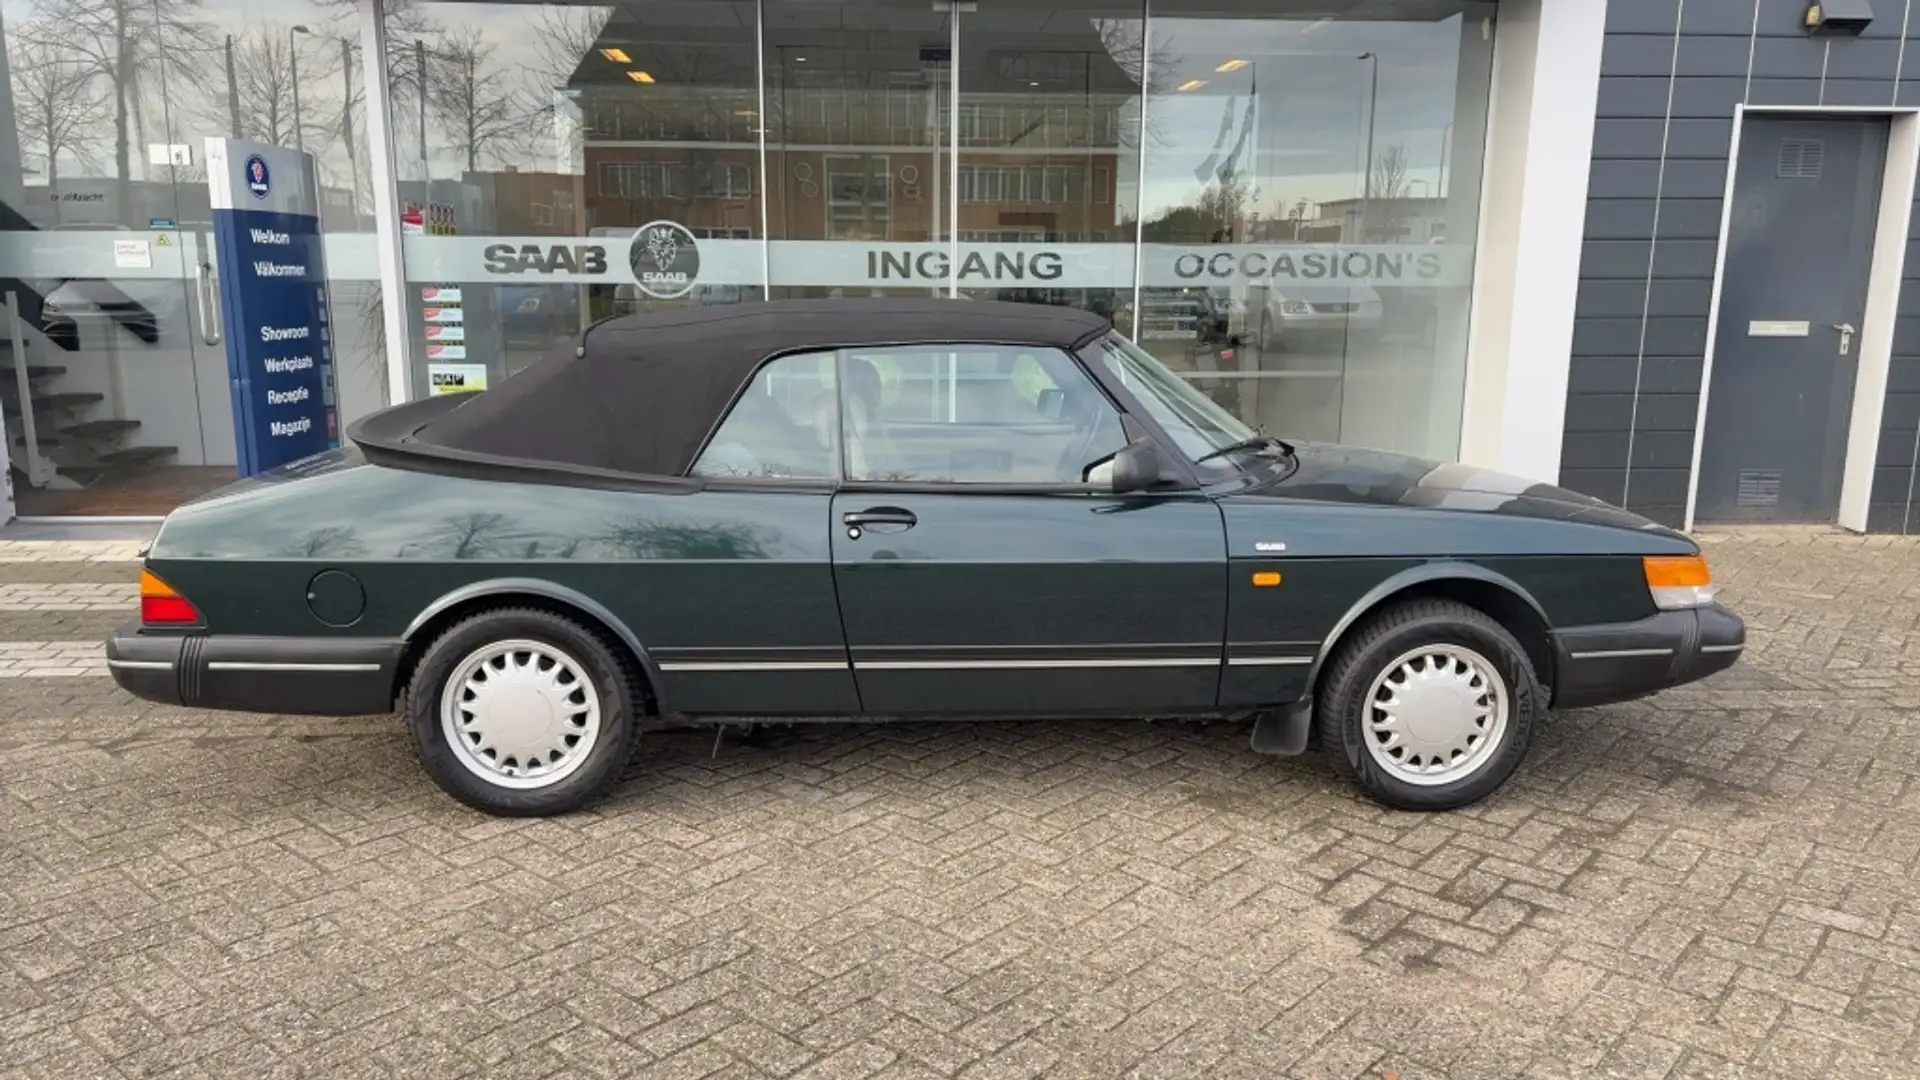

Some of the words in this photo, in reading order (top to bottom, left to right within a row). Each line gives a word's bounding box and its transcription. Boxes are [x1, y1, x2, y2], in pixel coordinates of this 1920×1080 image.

[249, 228, 290, 245] Welkom
[484, 243, 608, 275] SAAB
[868, 250, 1063, 280] INGANG
[1174, 251, 1441, 280] OCCASION'S
[642, 271, 687, 283] SAAB
[260, 325, 309, 342] Showroom
[264, 355, 313, 373] Werkplaats
[268, 386, 309, 405] Receptie
[270, 416, 311, 437] Magazijn
